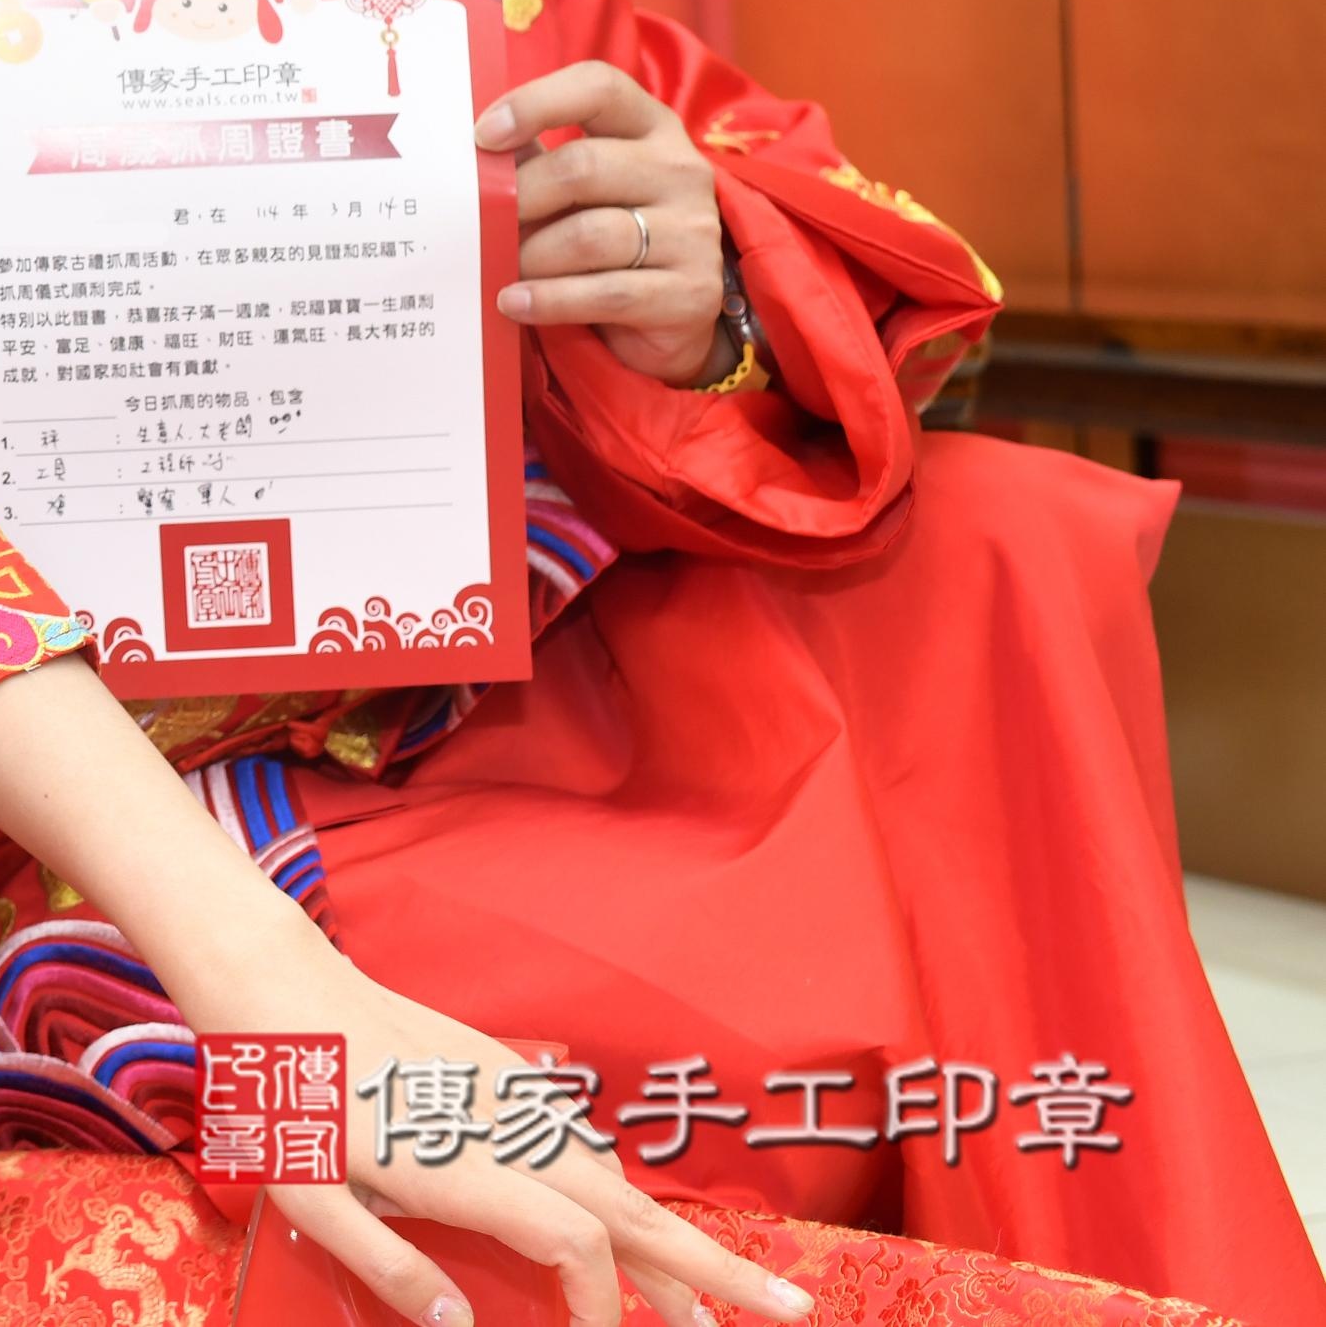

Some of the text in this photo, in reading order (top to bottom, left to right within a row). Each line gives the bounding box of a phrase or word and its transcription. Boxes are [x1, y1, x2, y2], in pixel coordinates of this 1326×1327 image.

[116, 62, 302, 93] 傳家手工印章
[122, 90, 298, 110] www.seals.com.tw
[292, 203, 308, 220] 年
[348, 201, 362, 218] 月
[404, 199, 417, 216] 日
[0, 279, 155, 303] 抓周儀式順利完成。
[123, 387, 305, 413] 今日抓周的物品，包含
[1, 437, 14, 450] 1.
[2, 471, 16, 485] 2.
[4, 506, 18, 520] 3.
